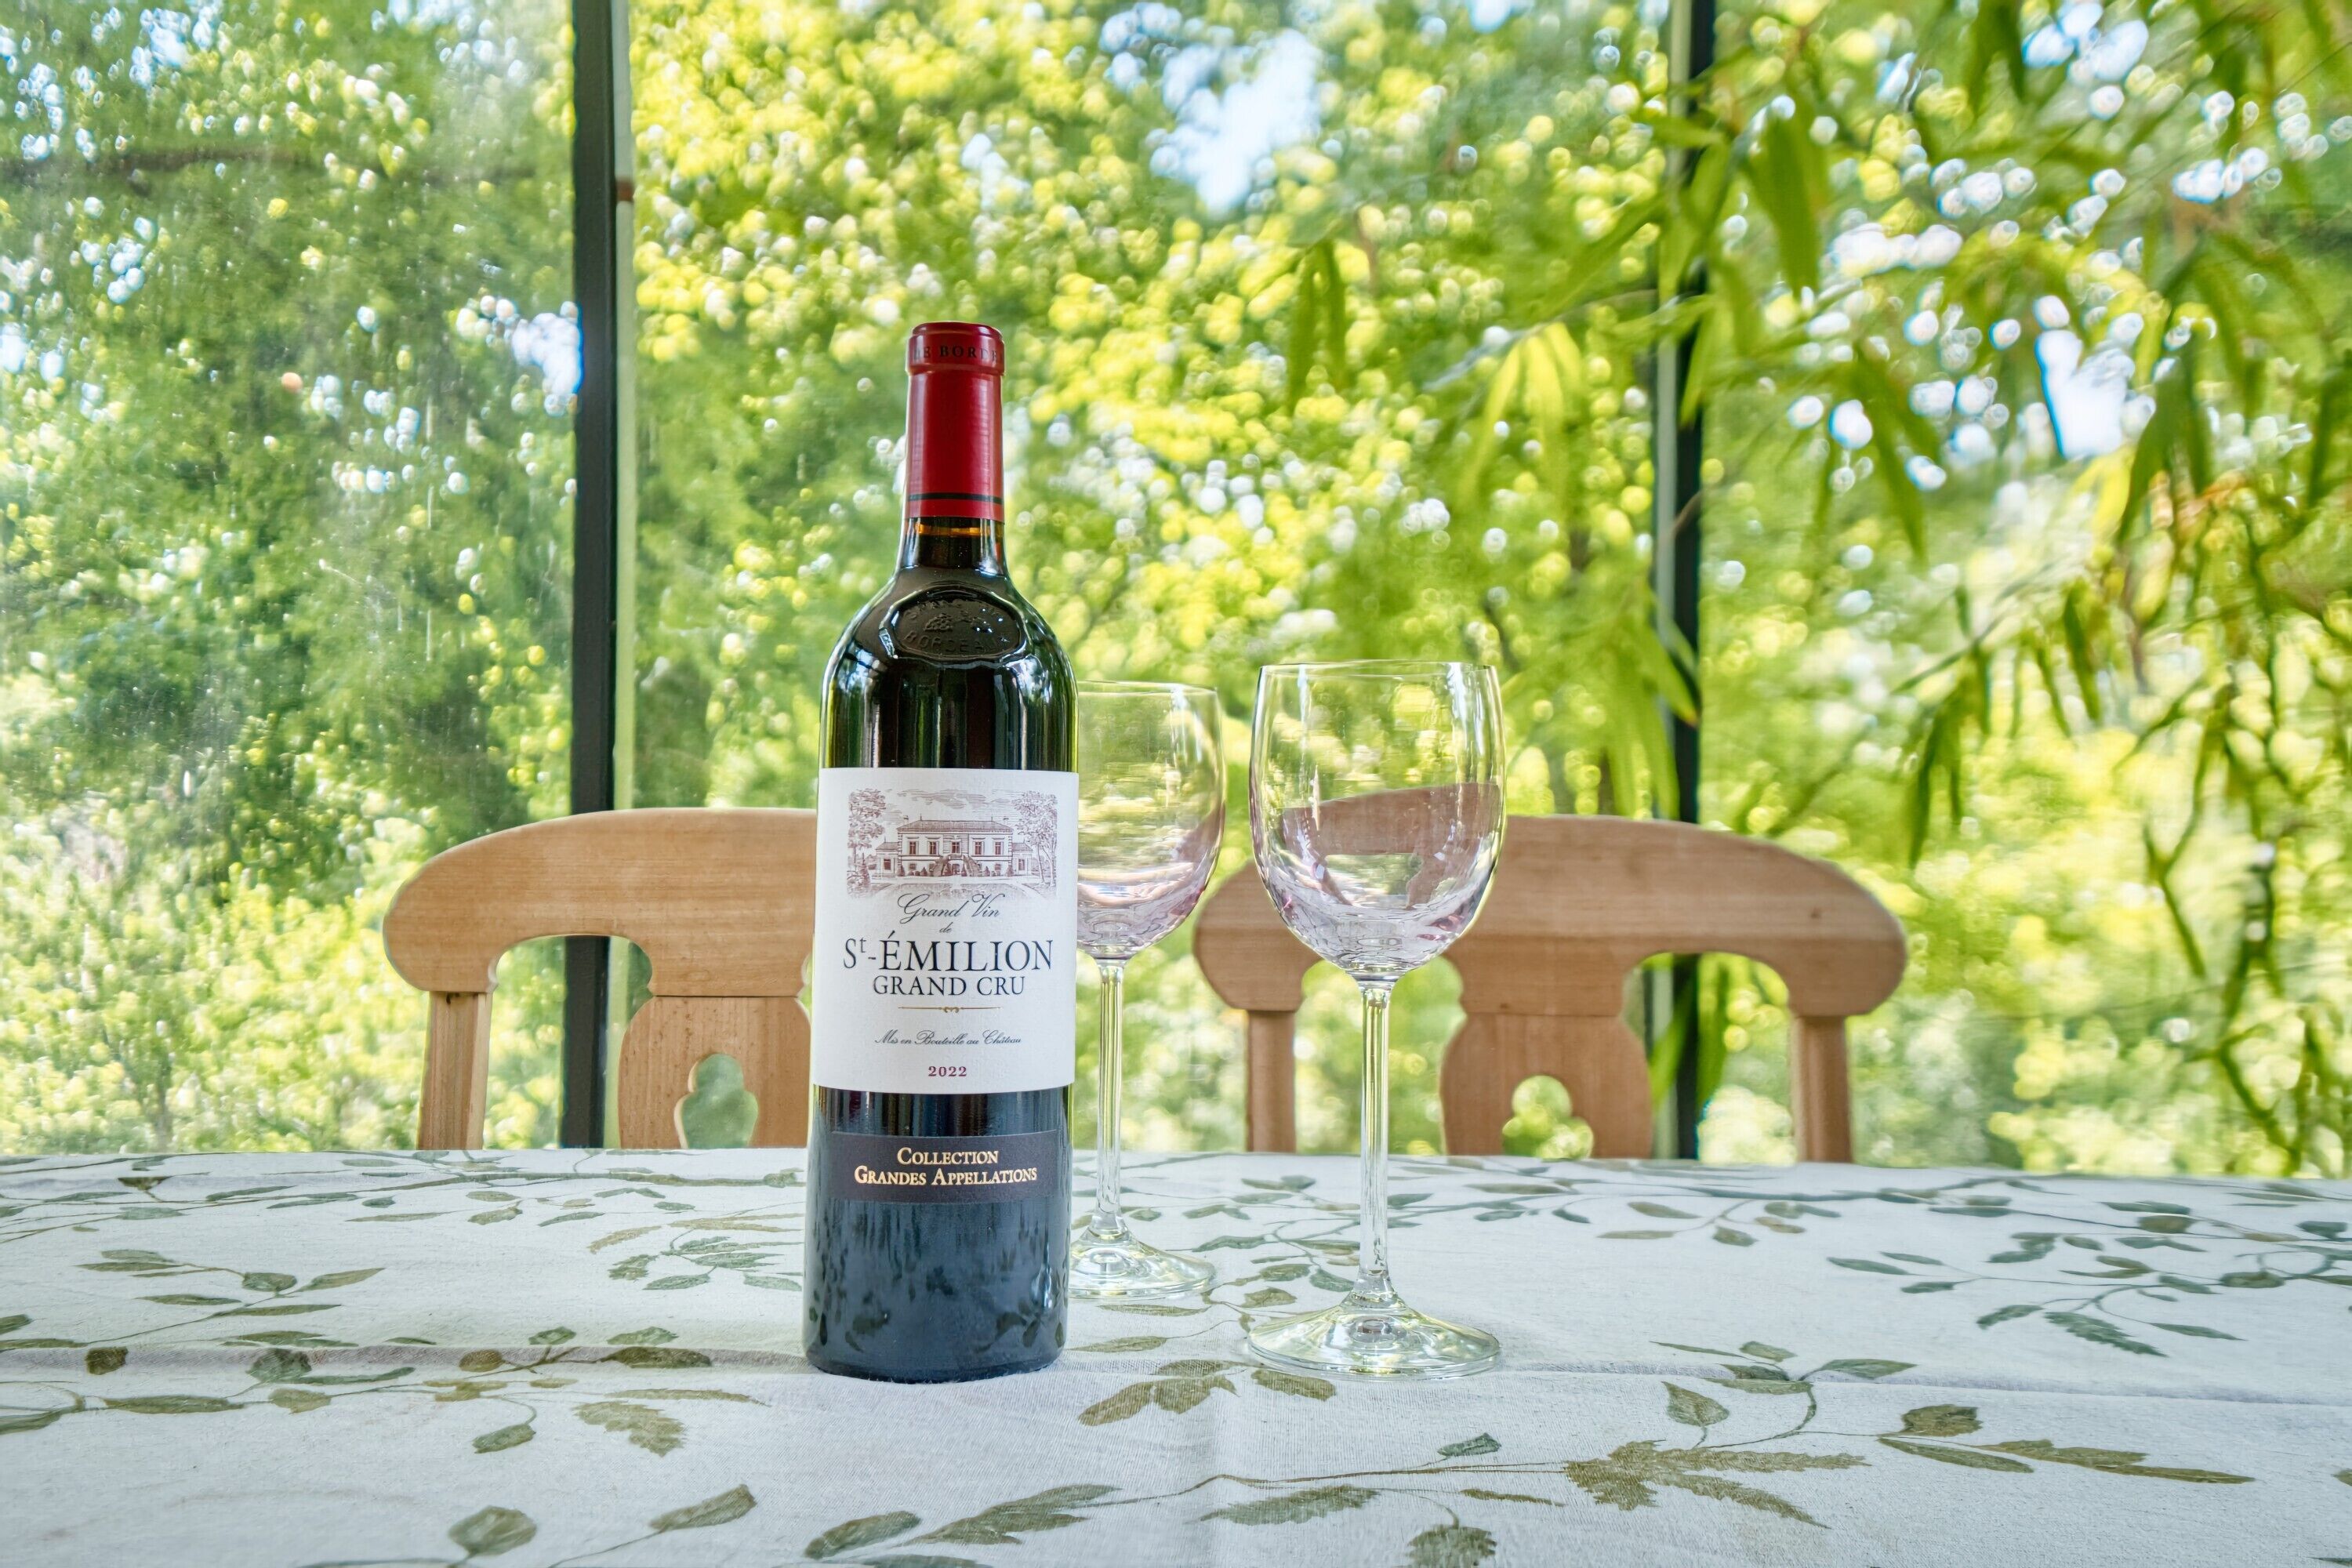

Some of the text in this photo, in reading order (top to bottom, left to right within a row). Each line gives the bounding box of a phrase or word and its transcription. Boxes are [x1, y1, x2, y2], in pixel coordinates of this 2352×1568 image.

[897, 893, 1005, 924] Grand Vin
[939, 922, 953, 934] de
[873, 975, 1025, 996] GRAND CRU
[874, 1029, 898, 1044] Mis
[914, 1029, 968, 1045] Bouteille
[982, 1029, 1022, 1044] Château
[927, 1065, 967, 1077] 2022
[897, 1147, 999, 1165] COLLECTION
[854, 1165, 1037, 1185] GRANDES APPELLATIONS
